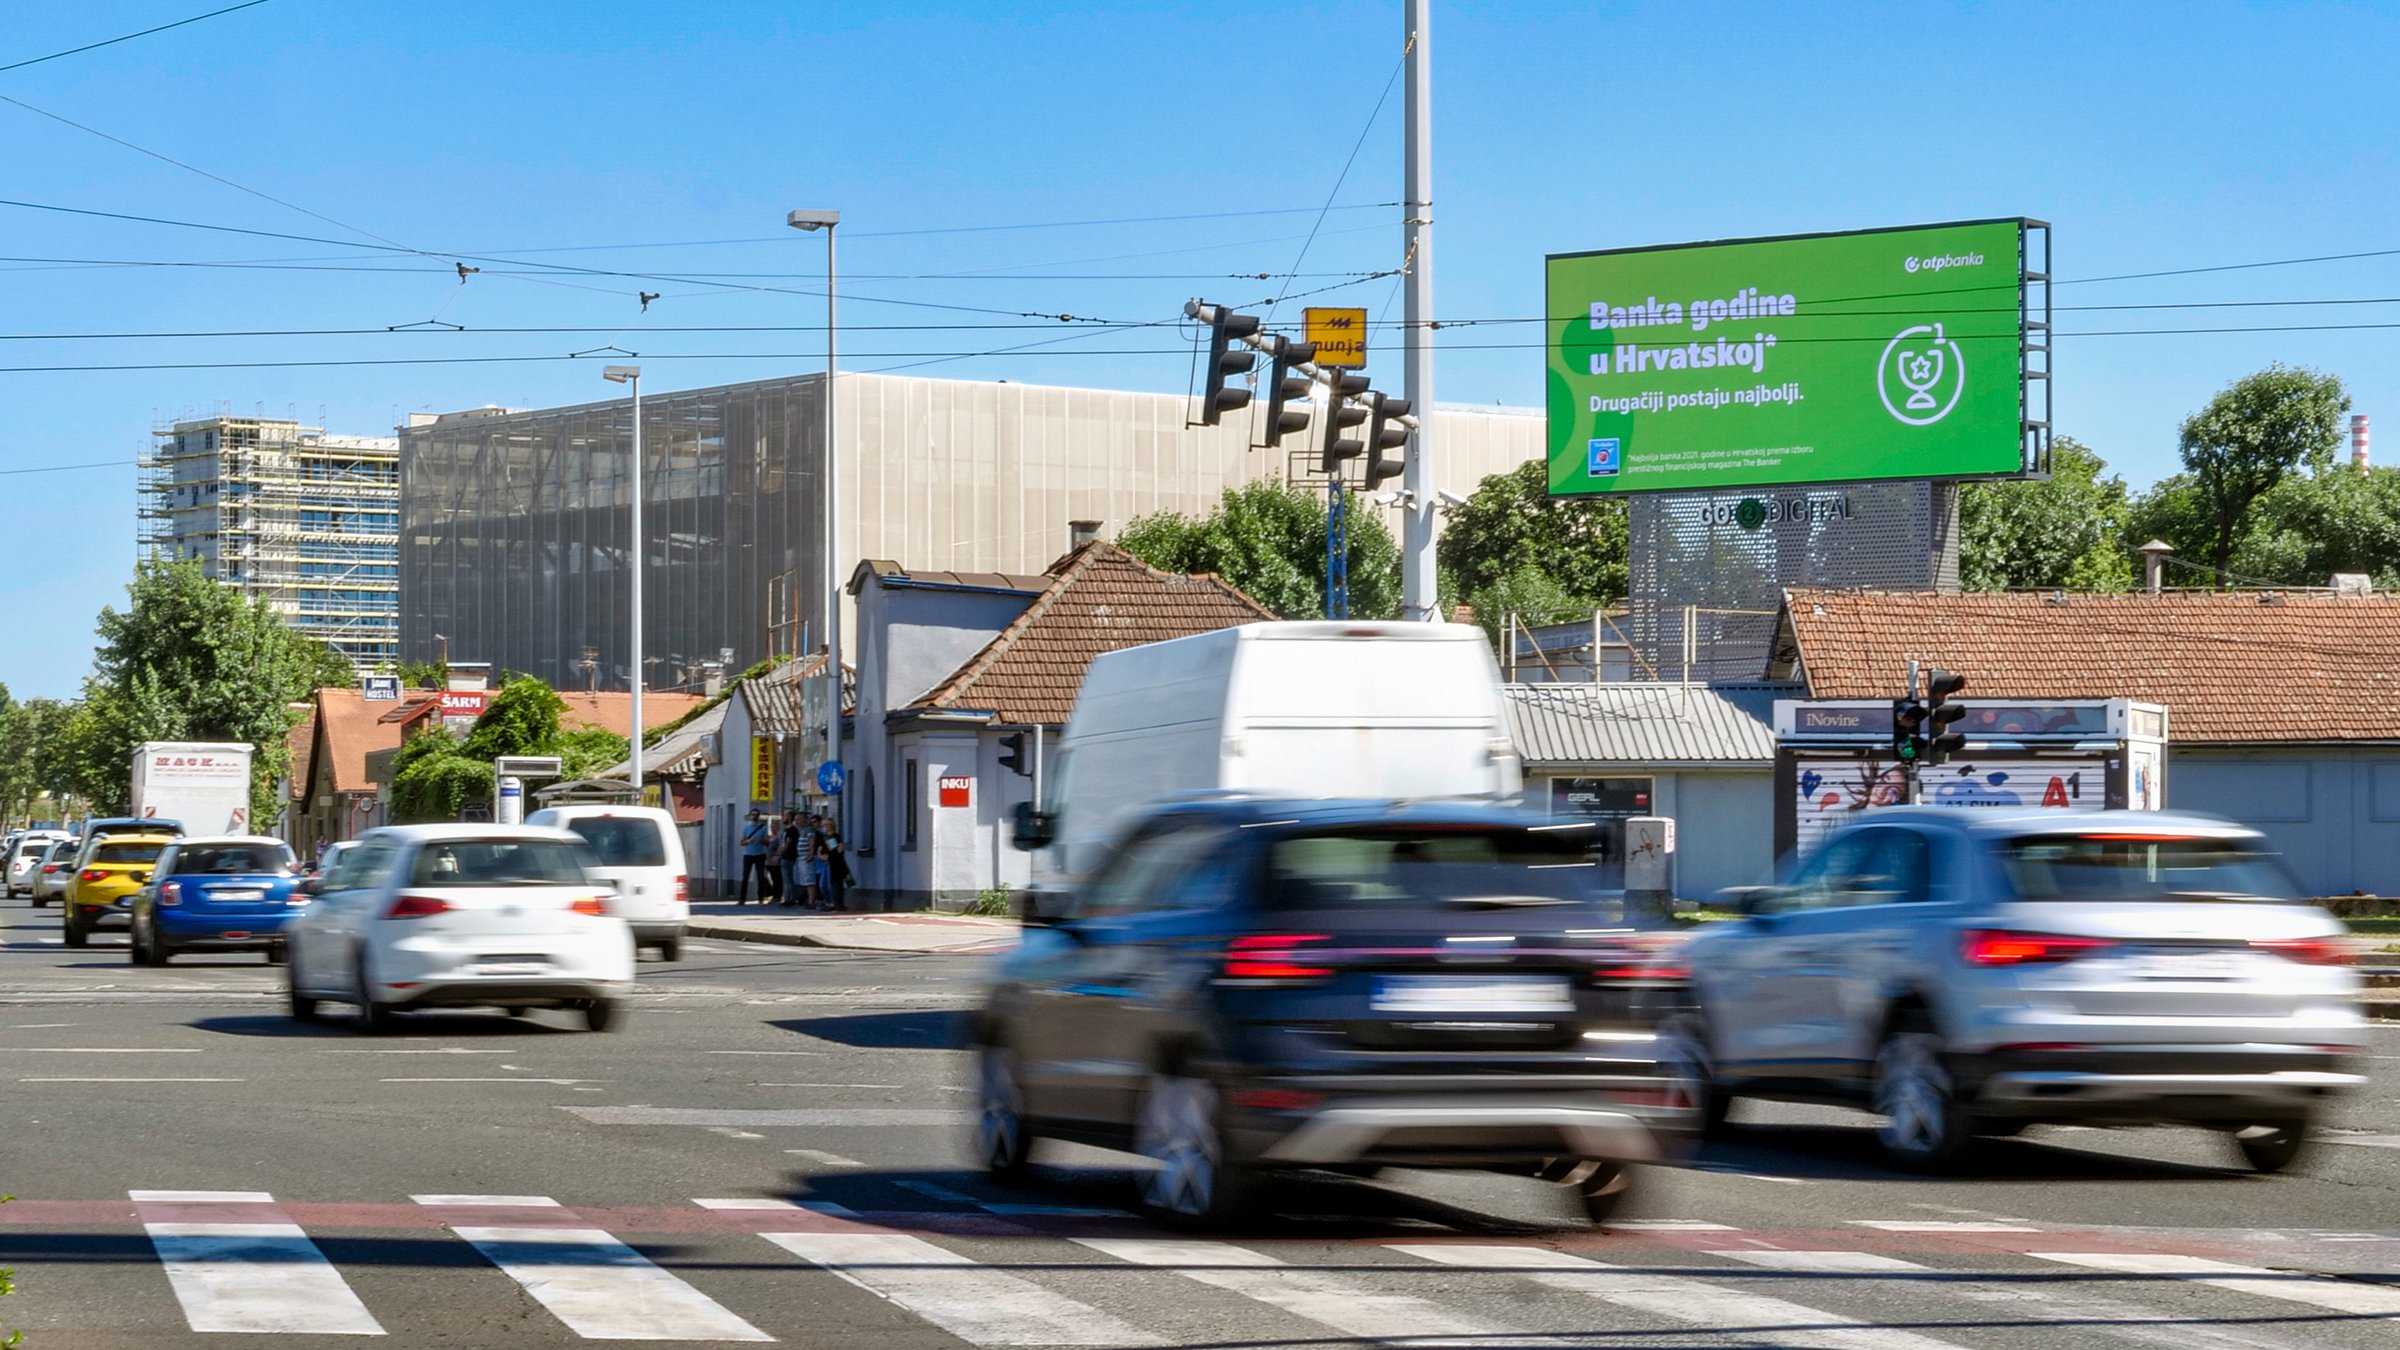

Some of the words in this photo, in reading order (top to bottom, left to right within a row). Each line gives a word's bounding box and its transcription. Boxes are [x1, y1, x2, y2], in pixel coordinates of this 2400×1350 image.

[1922, 251, 1984, 272] otpbanka
[1589, 296, 1683, 330] Banka
[1690, 287, 1796, 331] godine
[1309, 339, 1364, 356] munja
[1590, 353, 1608, 375] u
[1589, 391, 1663, 415] Drugačiji
[1667, 388, 1730, 411] postaju
[1734, 382, 1804, 406] najbolji.
[1660, 452, 1681, 460] banka
[1701, 450, 1725, 460] godine
[1732, 448, 1766, 457] Hrvatskoj
[1767, 447, 1790, 457] prema
[1791, 445, 1814, 455] izboru
[1627, 464, 1665, 474] prestižnog
[1665, 461, 1707, 472] financijskog
[1707, 460, 1742, 470] magazina
[1743, 459, 1756, 467] The
[1756, 458, 1782, 466] Banker
[1699, 504, 1731, 525] GO
[1768, 496, 1856, 523] DIGITAL
[367, 689, 396, 699] HOSTEL
[441, 693, 481, 708] ŠARM
[1806, 713, 1860, 727] iNovine
[941, 778, 969, 789] INKU
[2041, 772, 2080, 807] A1
